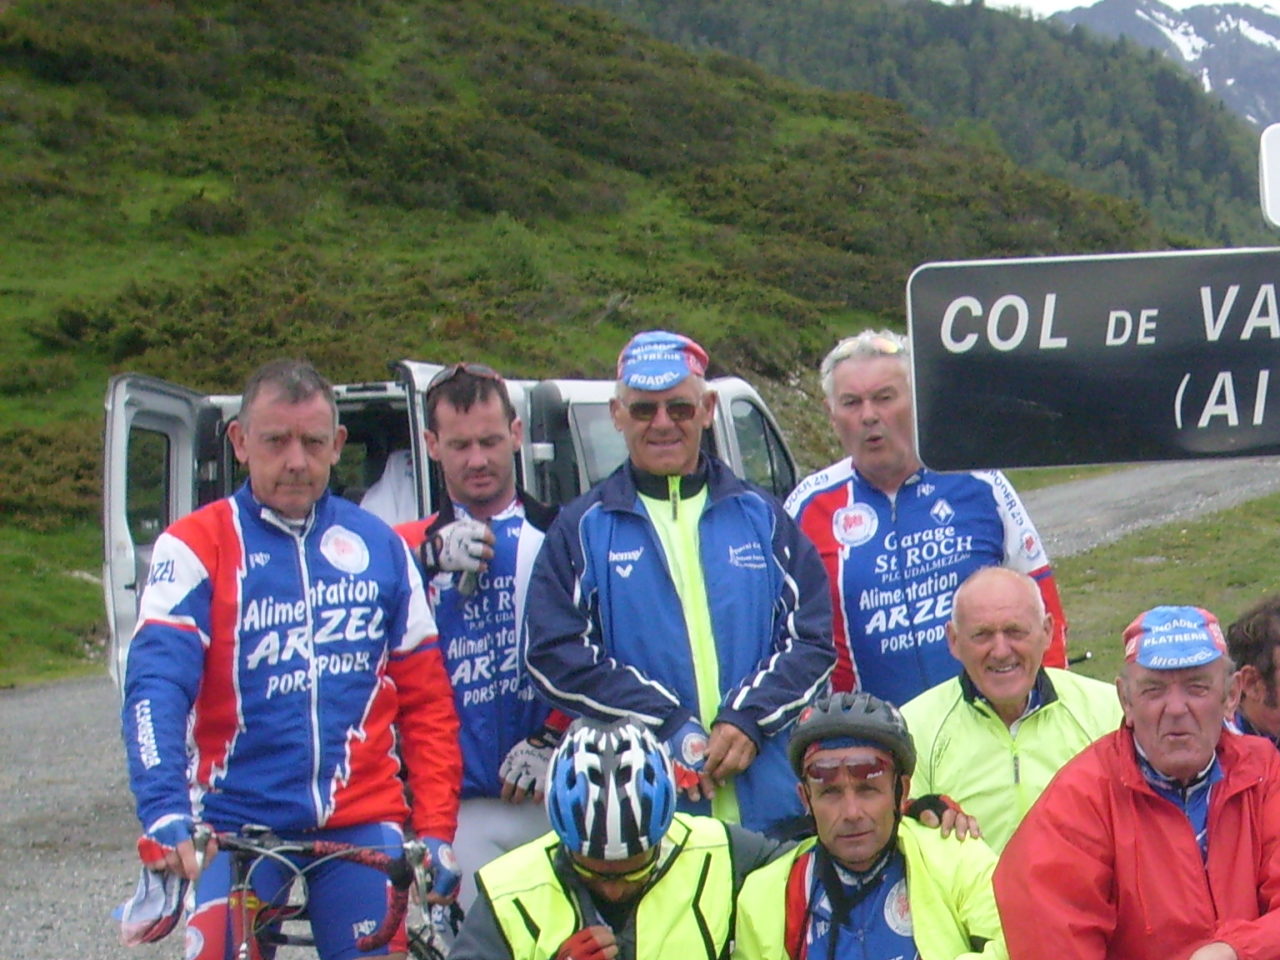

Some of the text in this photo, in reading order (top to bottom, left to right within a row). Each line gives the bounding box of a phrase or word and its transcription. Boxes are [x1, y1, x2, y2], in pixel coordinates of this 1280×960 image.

[939, 293, 1069, 355] COL
[1104, 308, 1159, 347] DE
[874, 535, 973, 575] St ROCH
[884, 525, 955, 551] Garage
[243, 574, 379, 633] Alimentation
[859, 570, 958, 610] Alimentation
[865, 594, 953, 636] ARZE
[246, 606, 385, 670] ARZEL
[447, 627, 516, 660] Alimenta
[881, 625, 946, 654] PORSPOD
[451, 648, 518, 686] ARZ
[463, 678, 519, 707] PORSPO
